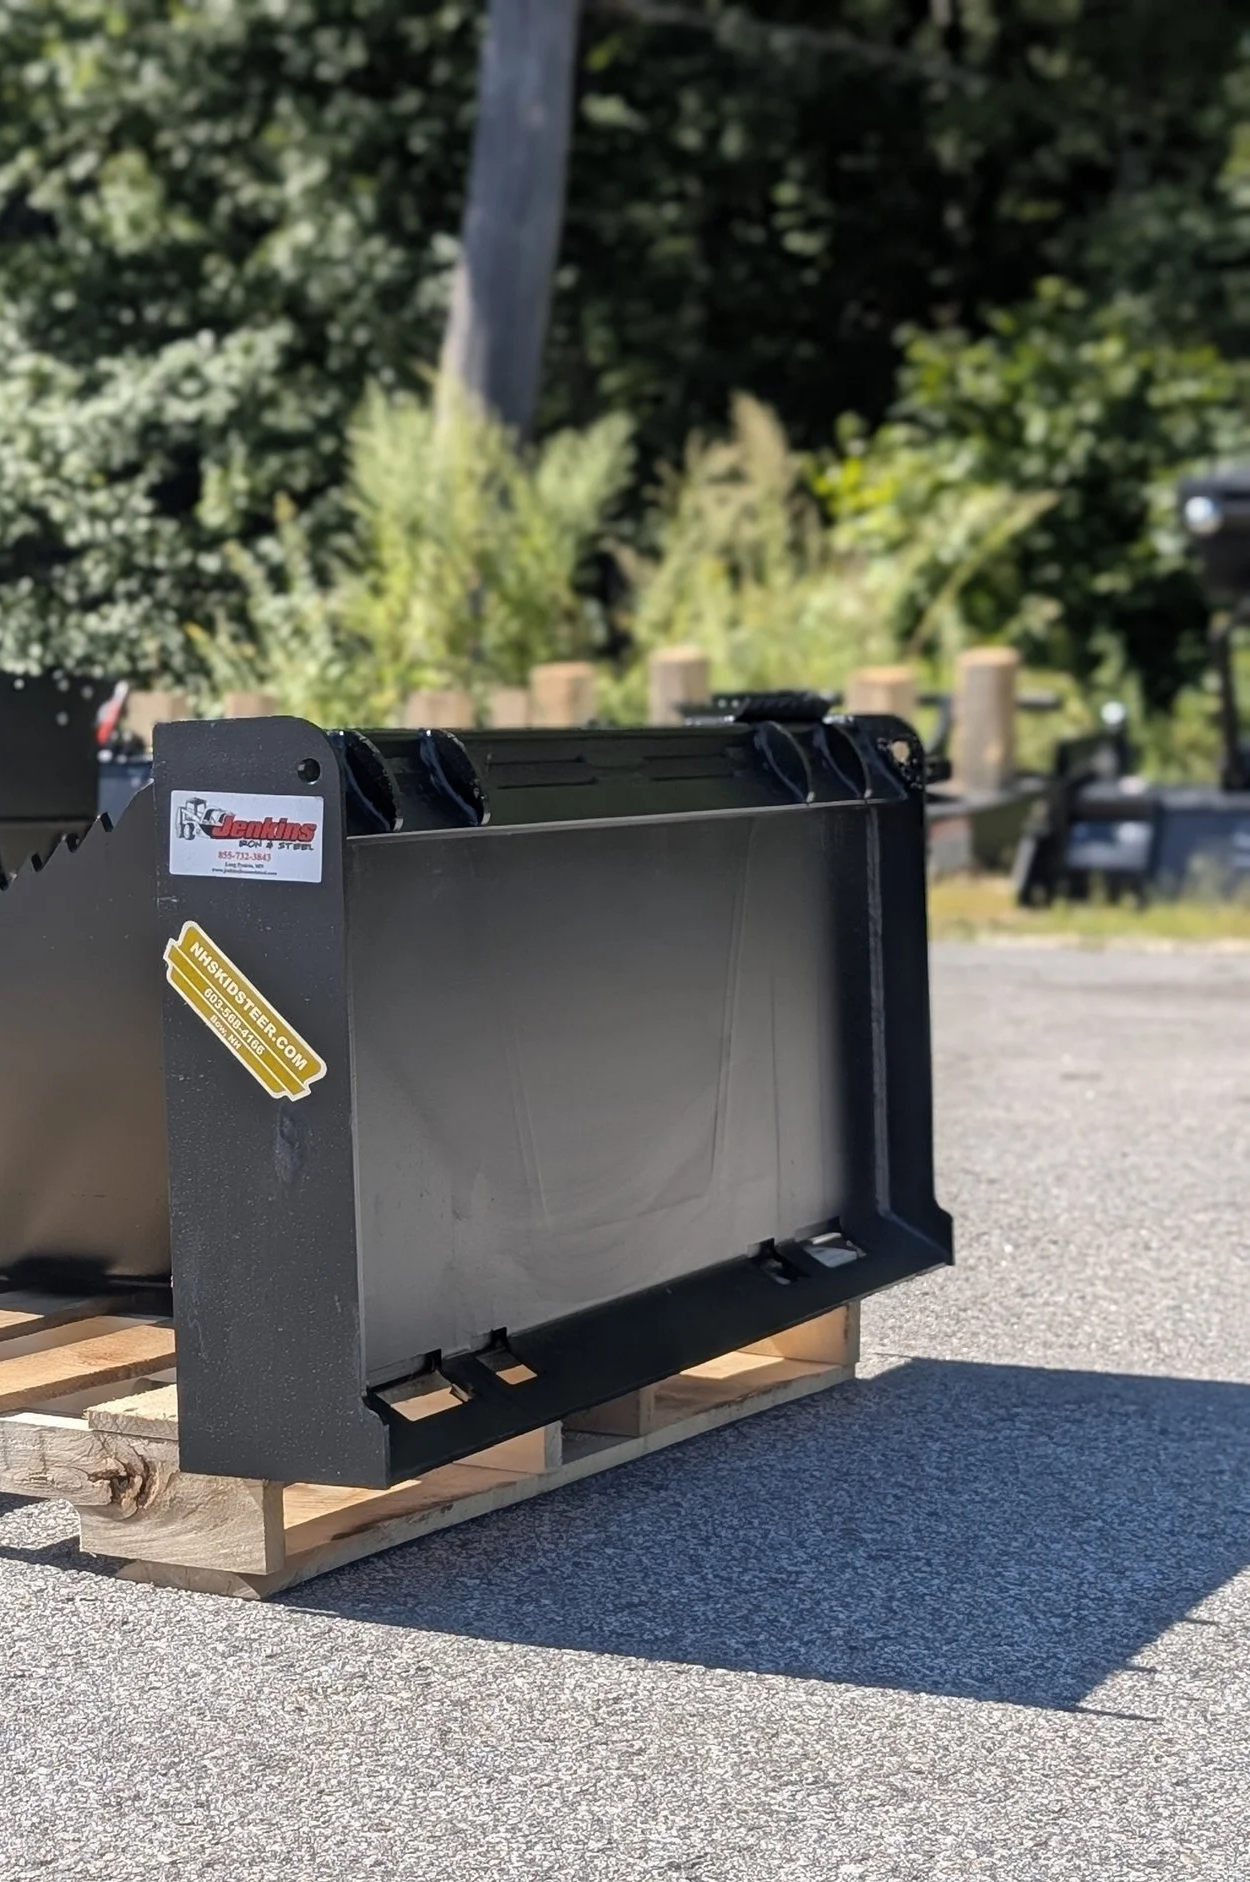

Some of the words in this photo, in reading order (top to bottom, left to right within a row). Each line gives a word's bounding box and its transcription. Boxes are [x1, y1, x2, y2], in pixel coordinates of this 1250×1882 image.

[212, 814, 317, 842] Jenkins
[239, 840, 262, 848] IRON
[278, 842, 314, 851] STEEL
[190, 941, 308, 1071] NHSKIDSTEER.COM
[228, 1034, 243, 1050] NH
